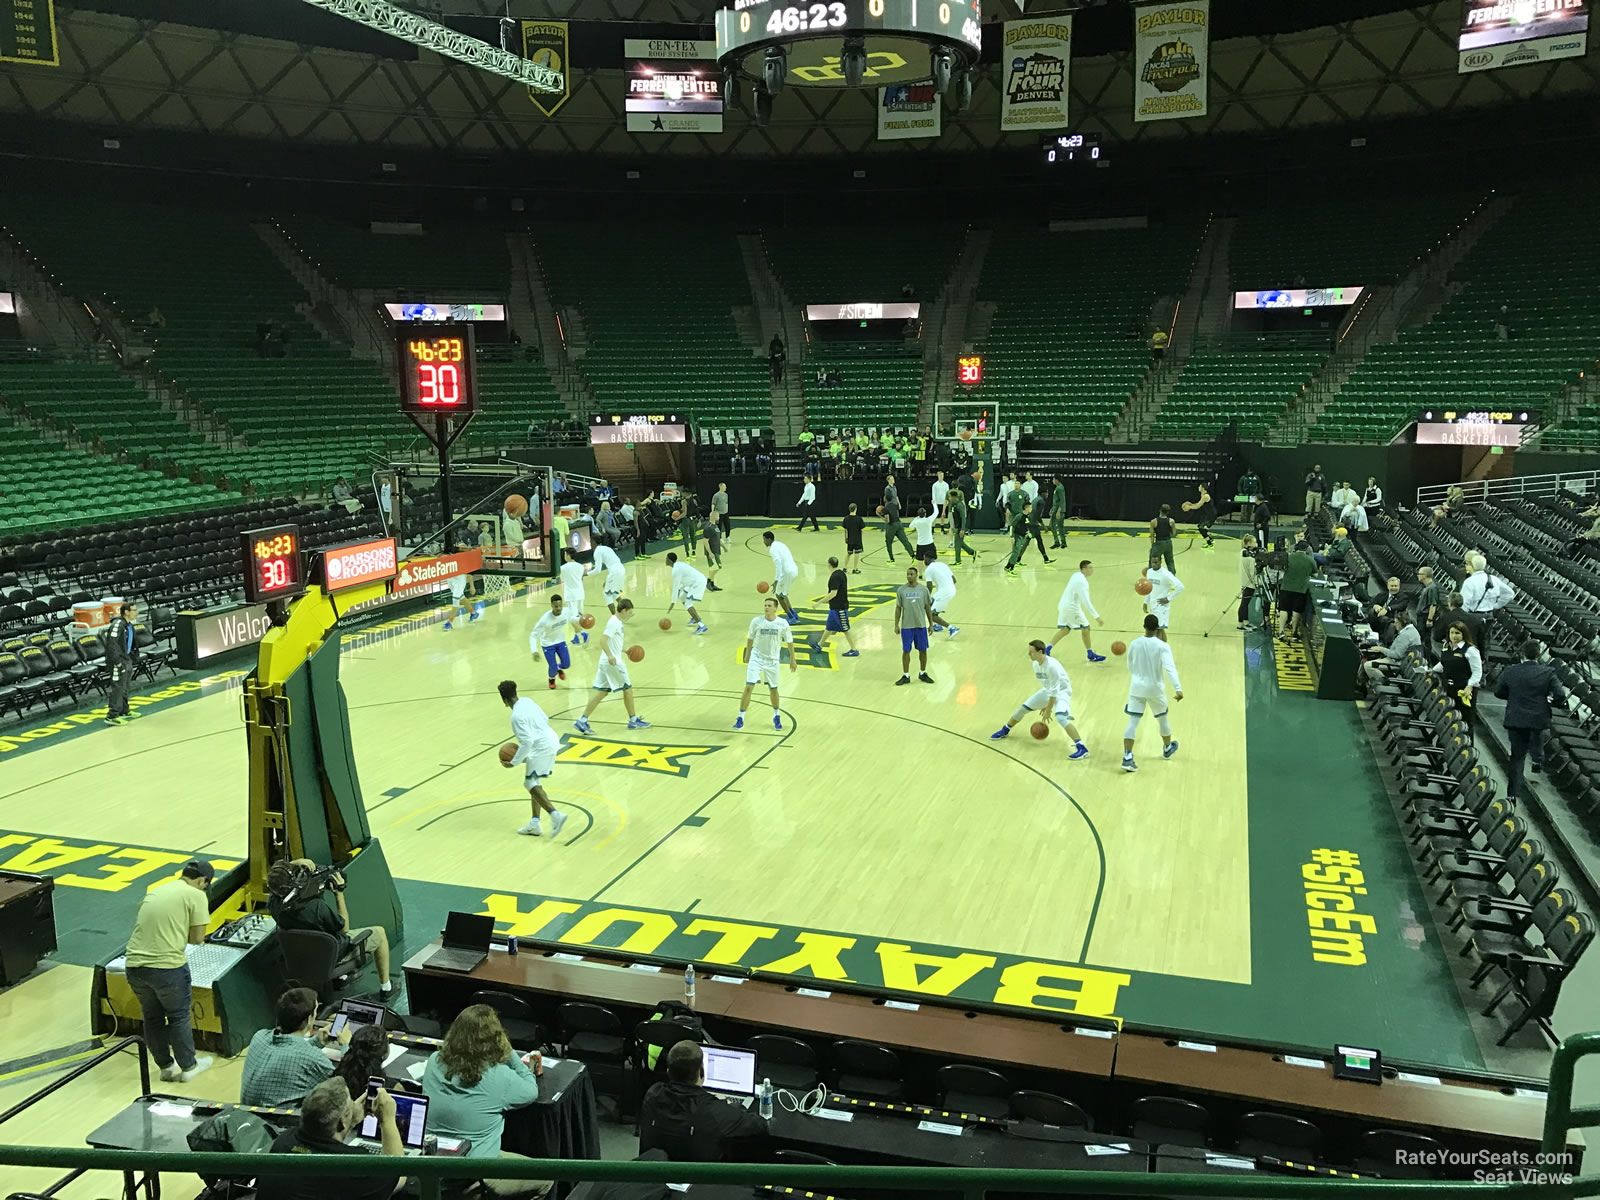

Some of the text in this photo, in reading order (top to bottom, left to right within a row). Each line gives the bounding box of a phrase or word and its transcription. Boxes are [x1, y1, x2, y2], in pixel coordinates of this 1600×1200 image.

[766, 2, 848, 34] 46:23
[1138, 8, 1206, 33] BAYLOR
[526, 24, 565, 38] BAYLOR
[1005, 24, 1068, 46] BAYLOR
[648, 40, 696, 51] CEN-TEX
[1469, 56, 1489, 65] KIA
[1024, 61, 1063, 76] FINAL
[1016, 91, 1056, 101] DENVER
[1143, 94, 1199, 106] NATIONAL
[1138, 102, 1203, 116] CHAMPIONS
[1057, 135, 1083, 147] 46:23
[1048, 150, 1056, 162] 0
[1091, 147, 1099, 159] 0
[410, 340, 462, 362] 46:23
[962, 366, 978, 380] 30
[420, 365, 459, 403] 30
[611, 433, 665, 443] BASKETBALL
[1441, 433, 1509, 446] BASKETBALL
[341, 546, 394, 567] PARSONS
[262, 559, 287, 588] 30
[342, 558, 395, 580] ROOFING
[1301, 848, 1378, 966] #SicEm
[482, 893, 1131, 1018] BAYLOR
